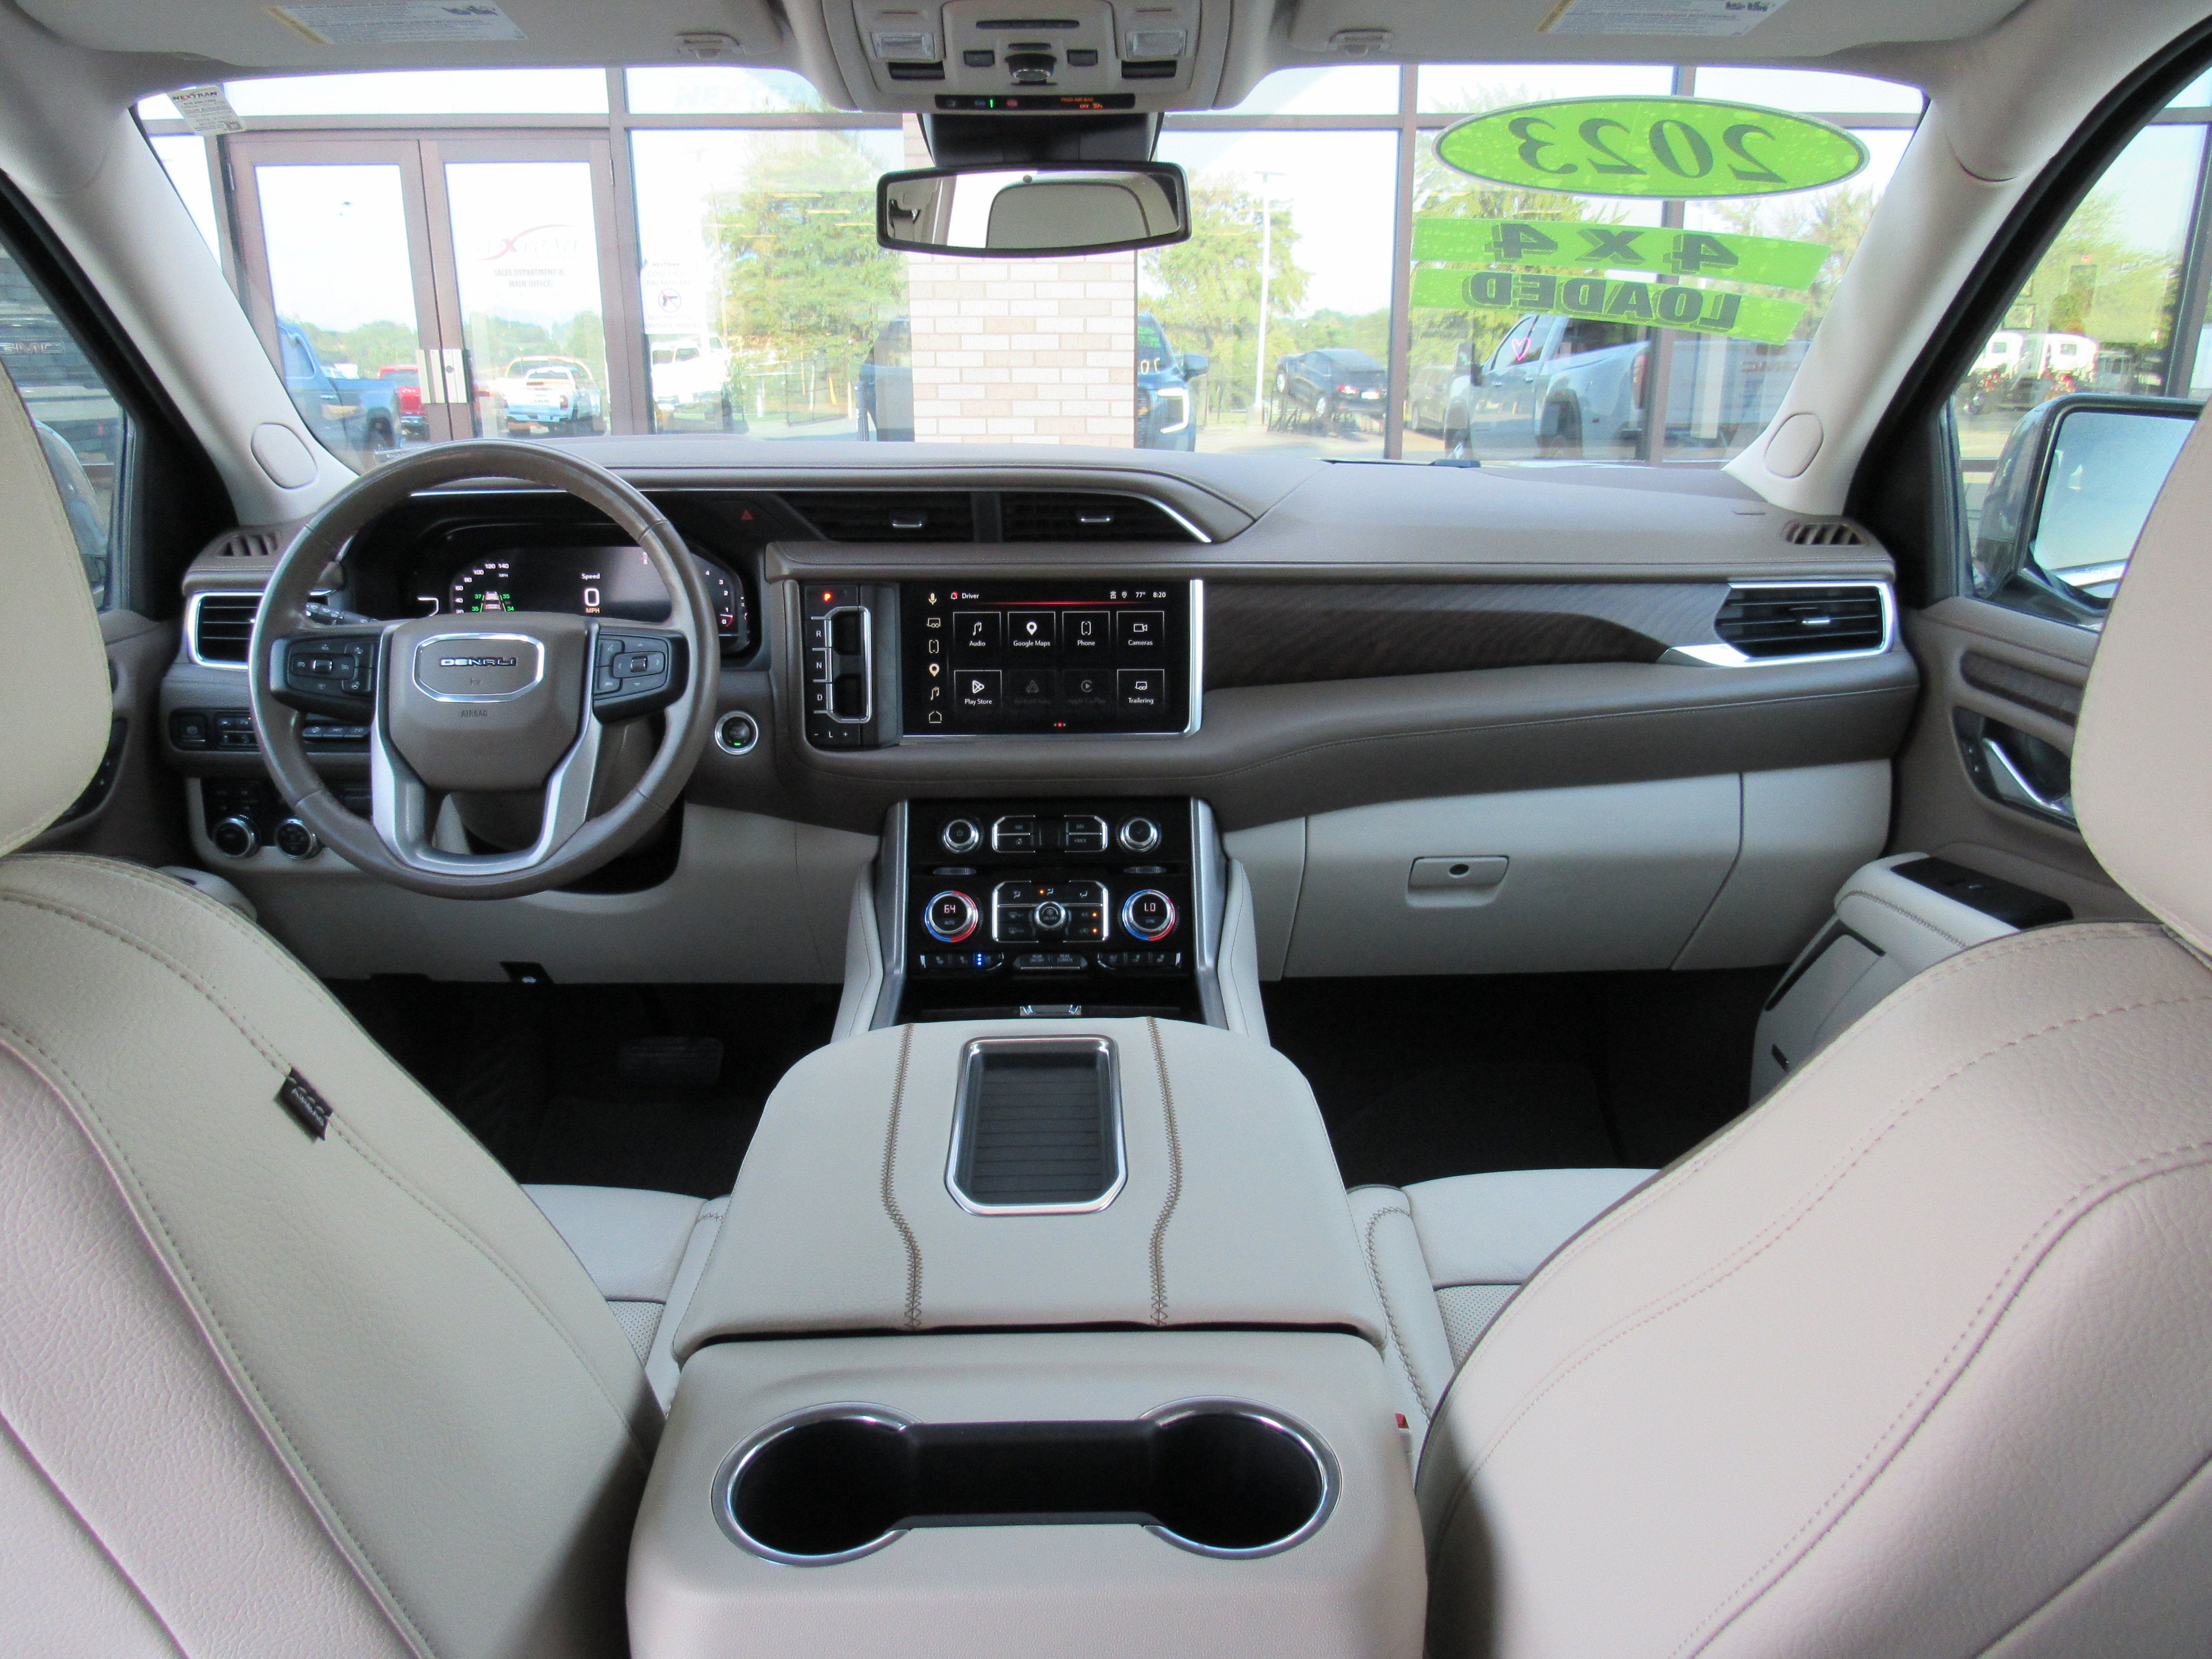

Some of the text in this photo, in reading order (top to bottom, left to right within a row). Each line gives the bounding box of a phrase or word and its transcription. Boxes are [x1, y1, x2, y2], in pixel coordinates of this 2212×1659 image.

[584, 588, 600, 607] 0
[823, 593, 831, 601] P
[440, 658, 518, 666] DENALI
[944, 904, 956, 914] 64
